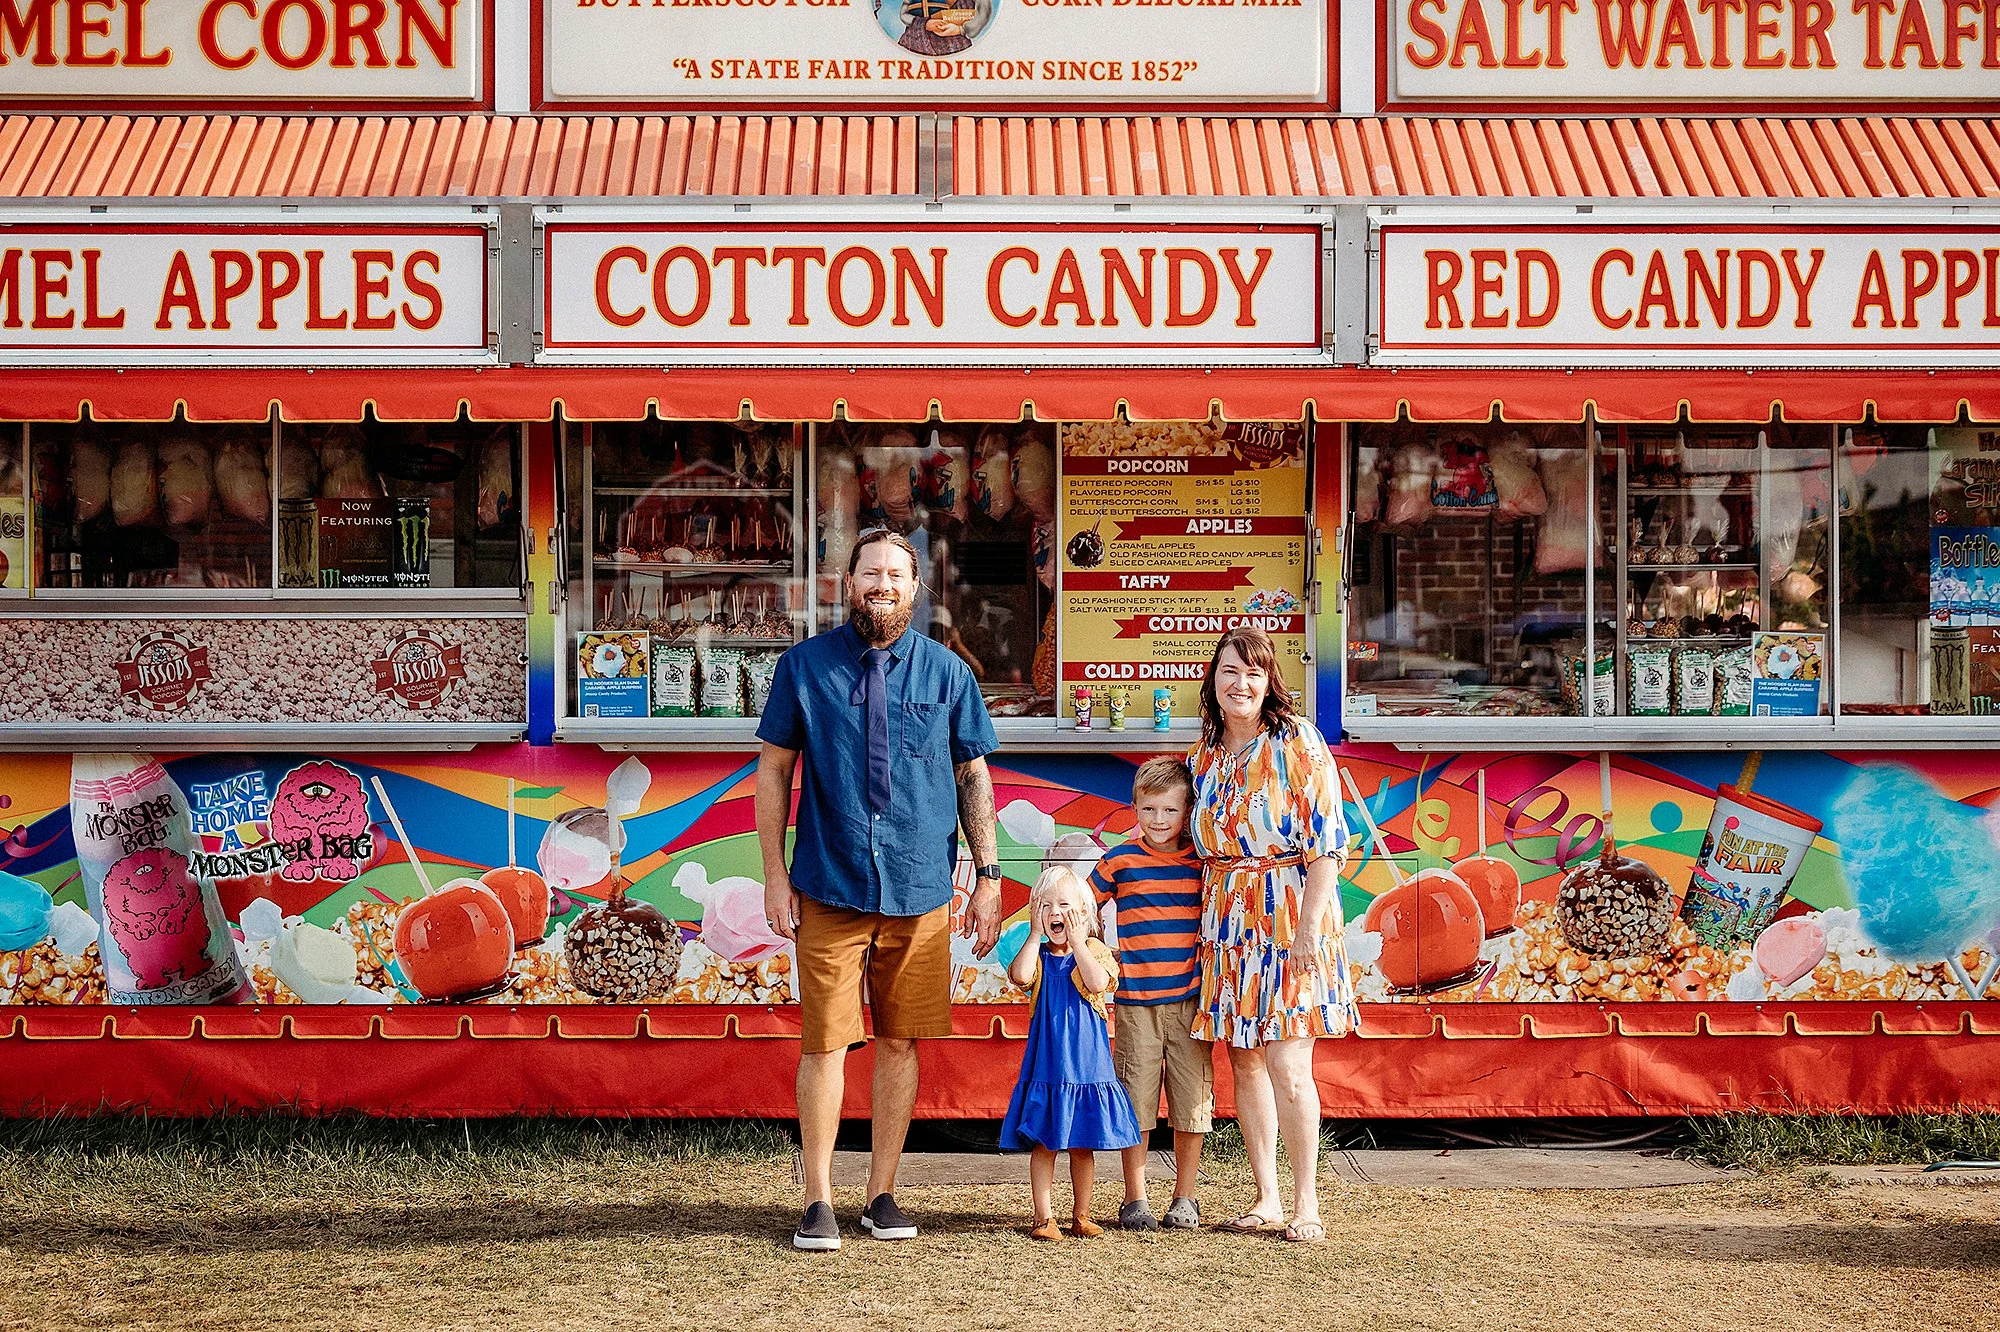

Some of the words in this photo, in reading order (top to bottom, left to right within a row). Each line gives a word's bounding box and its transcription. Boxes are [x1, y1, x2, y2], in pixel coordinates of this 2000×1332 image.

[0, 0, 174, 67] MEL
[198, 0, 457, 70] CORN
[1404, 0, 1582, 69] SALT
[1600, 0, 1838, 69] WATER
[711, 60, 800, 80] STATE
[808, 60, 870, 80] FAIR
[878, 60, 1032, 80] TRADITION
[1042, 60, 1123, 81] SINCE
[154, 248, 443, 332] APPLES
[594, 245, 948, 328] COTTON
[986, 245, 1274, 328] CANDY
[1424, 248, 1560, 329] RED
[1591, 248, 1825, 329] CANDY
[1238, 423, 1285, 450] JESSOPS
[1108, 460, 1189, 473] POPCORN
[1430, 478, 1467, 507] Cotton
[1965, 483, 2000, 508] Sli
[322, 516, 392, 526] FEATURING
[1186, 519, 1253, 534] APPLES
[280, 572, 314, 584] JAVA
[342, 575, 389, 583] MONSTER
[1119, 575, 1170, 588] TAFFY
[1149, 617, 1222, 631] COTTON
[1227, 617, 1291, 631] CANDY
[138, 656, 192, 688] JESSOPS
[393, 654, 446, 686] JESSOPS
[1085, 664, 1136, 678] COLD
[1139, 664, 1204, 678] DRINKS
[151, 683, 184, 694] GOURMET
[152, 689, 186, 700] POPCORN
[406, 681, 439, 692] GOURMET
[407, 688, 439, 698] POPCORN
[1931, 697, 1966, 711] JAVA
[191, 772, 266, 809] TAKE
[190, 800, 268, 833] HOME
[222, 830, 245, 852] A
[1721, 824, 1744, 851] FUN
[1741, 839, 1764, 855] AT
[1765, 843, 1789, 858] THE
[1714, 839, 1785, 875] FAIR
[109, 986, 181, 1005] COTTON
